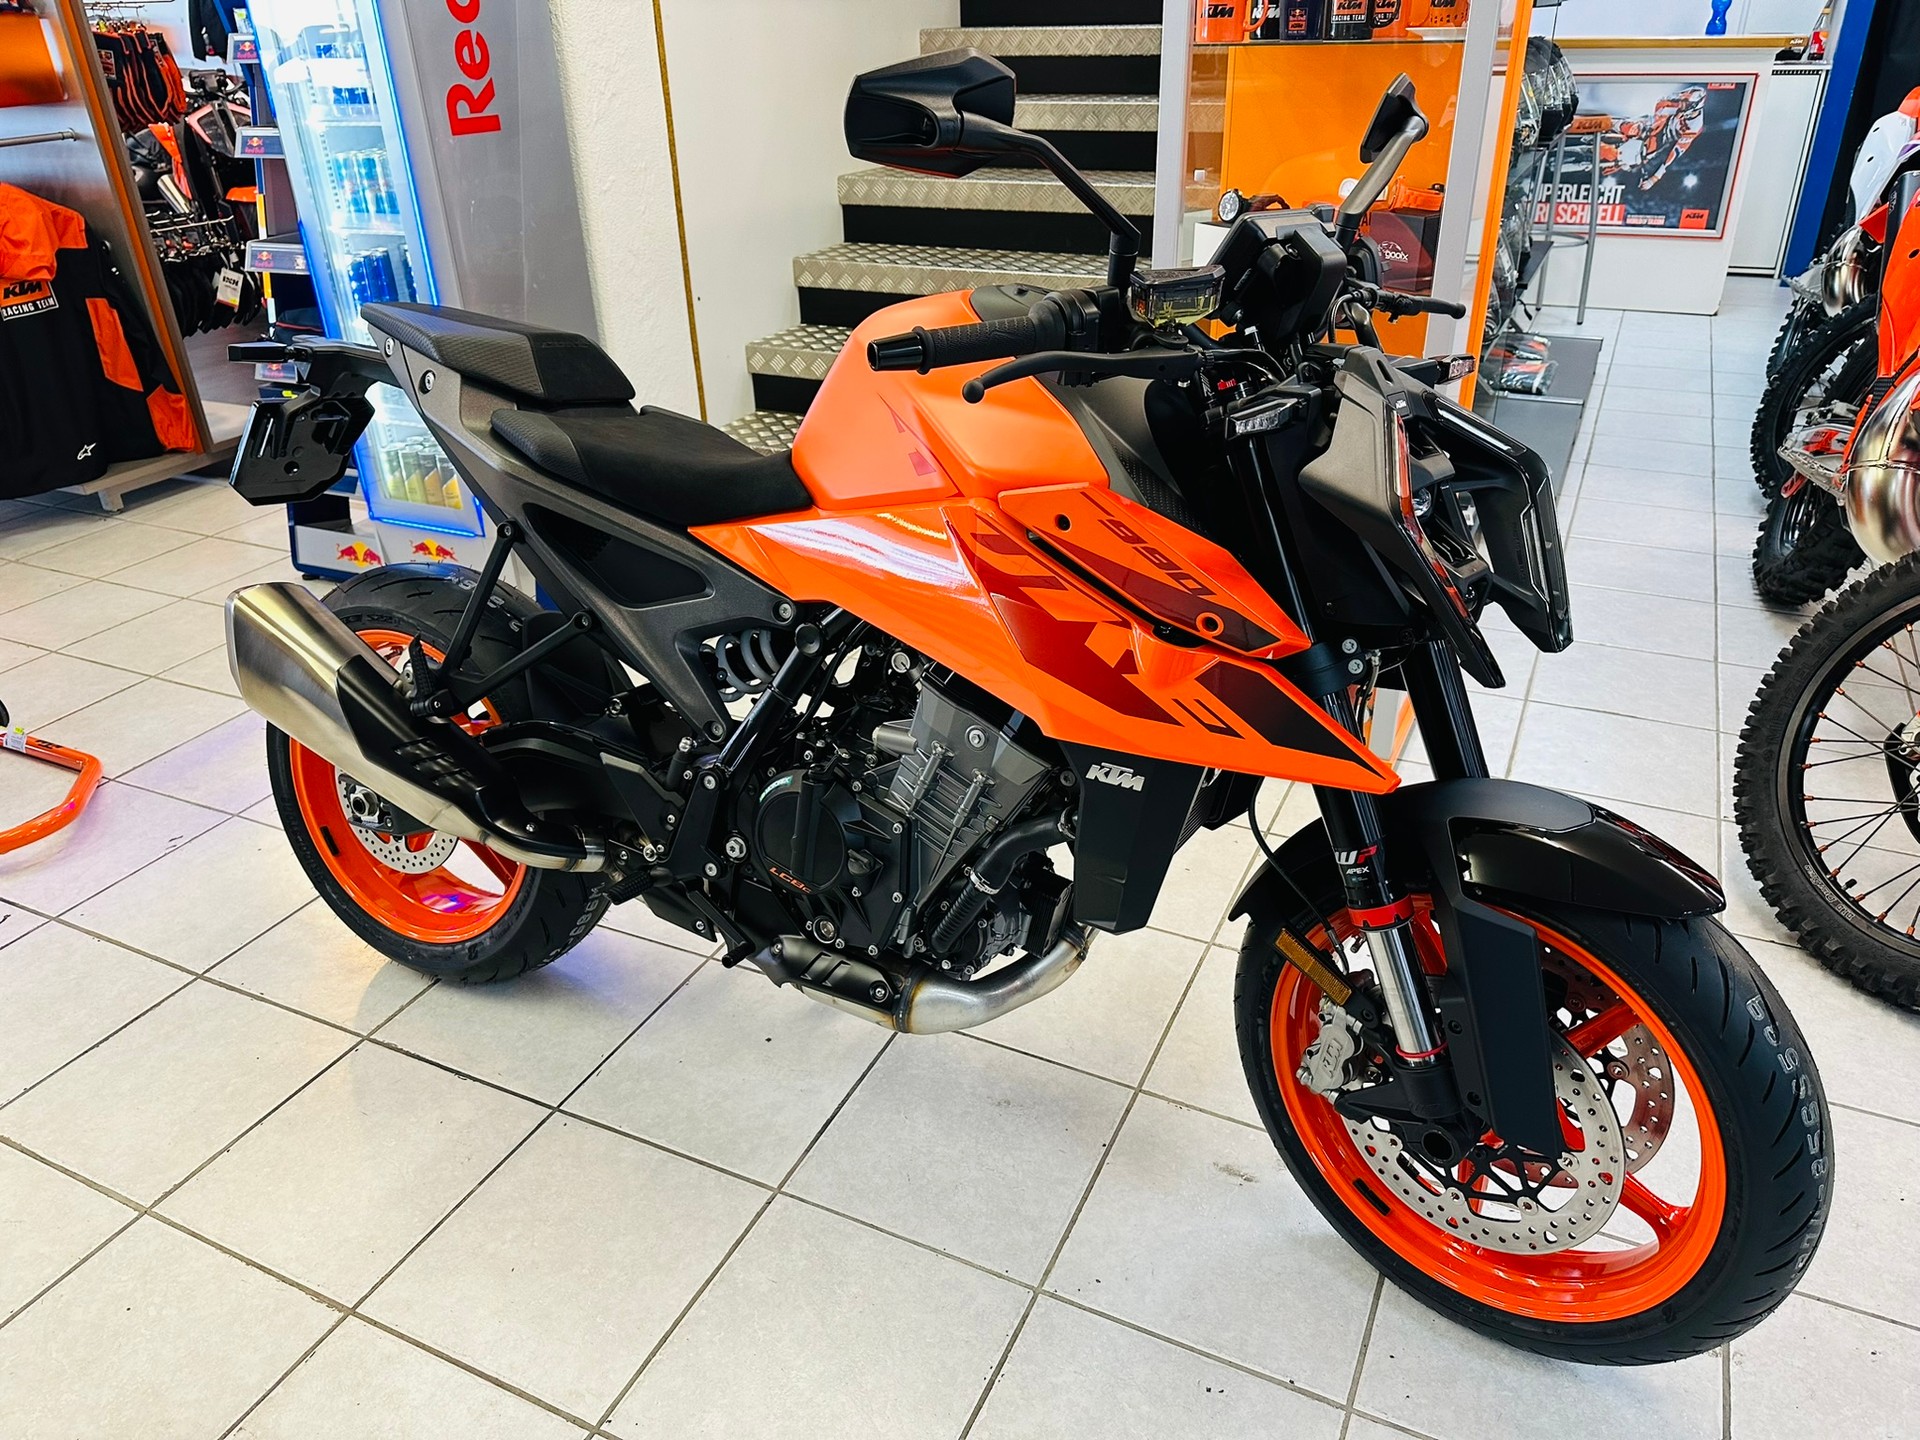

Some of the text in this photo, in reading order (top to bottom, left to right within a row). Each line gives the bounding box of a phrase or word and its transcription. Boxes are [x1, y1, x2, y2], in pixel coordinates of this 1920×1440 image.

[1201, 4, 1235, 18] KTM
[3, 280, 43, 299] KTM
[2, 302, 35, 317] RACING
[1097, 519, 1217, 595] 990
[1085, 762, 1145, 792] KTM
[1346, 866, 1370, 875] APEX
